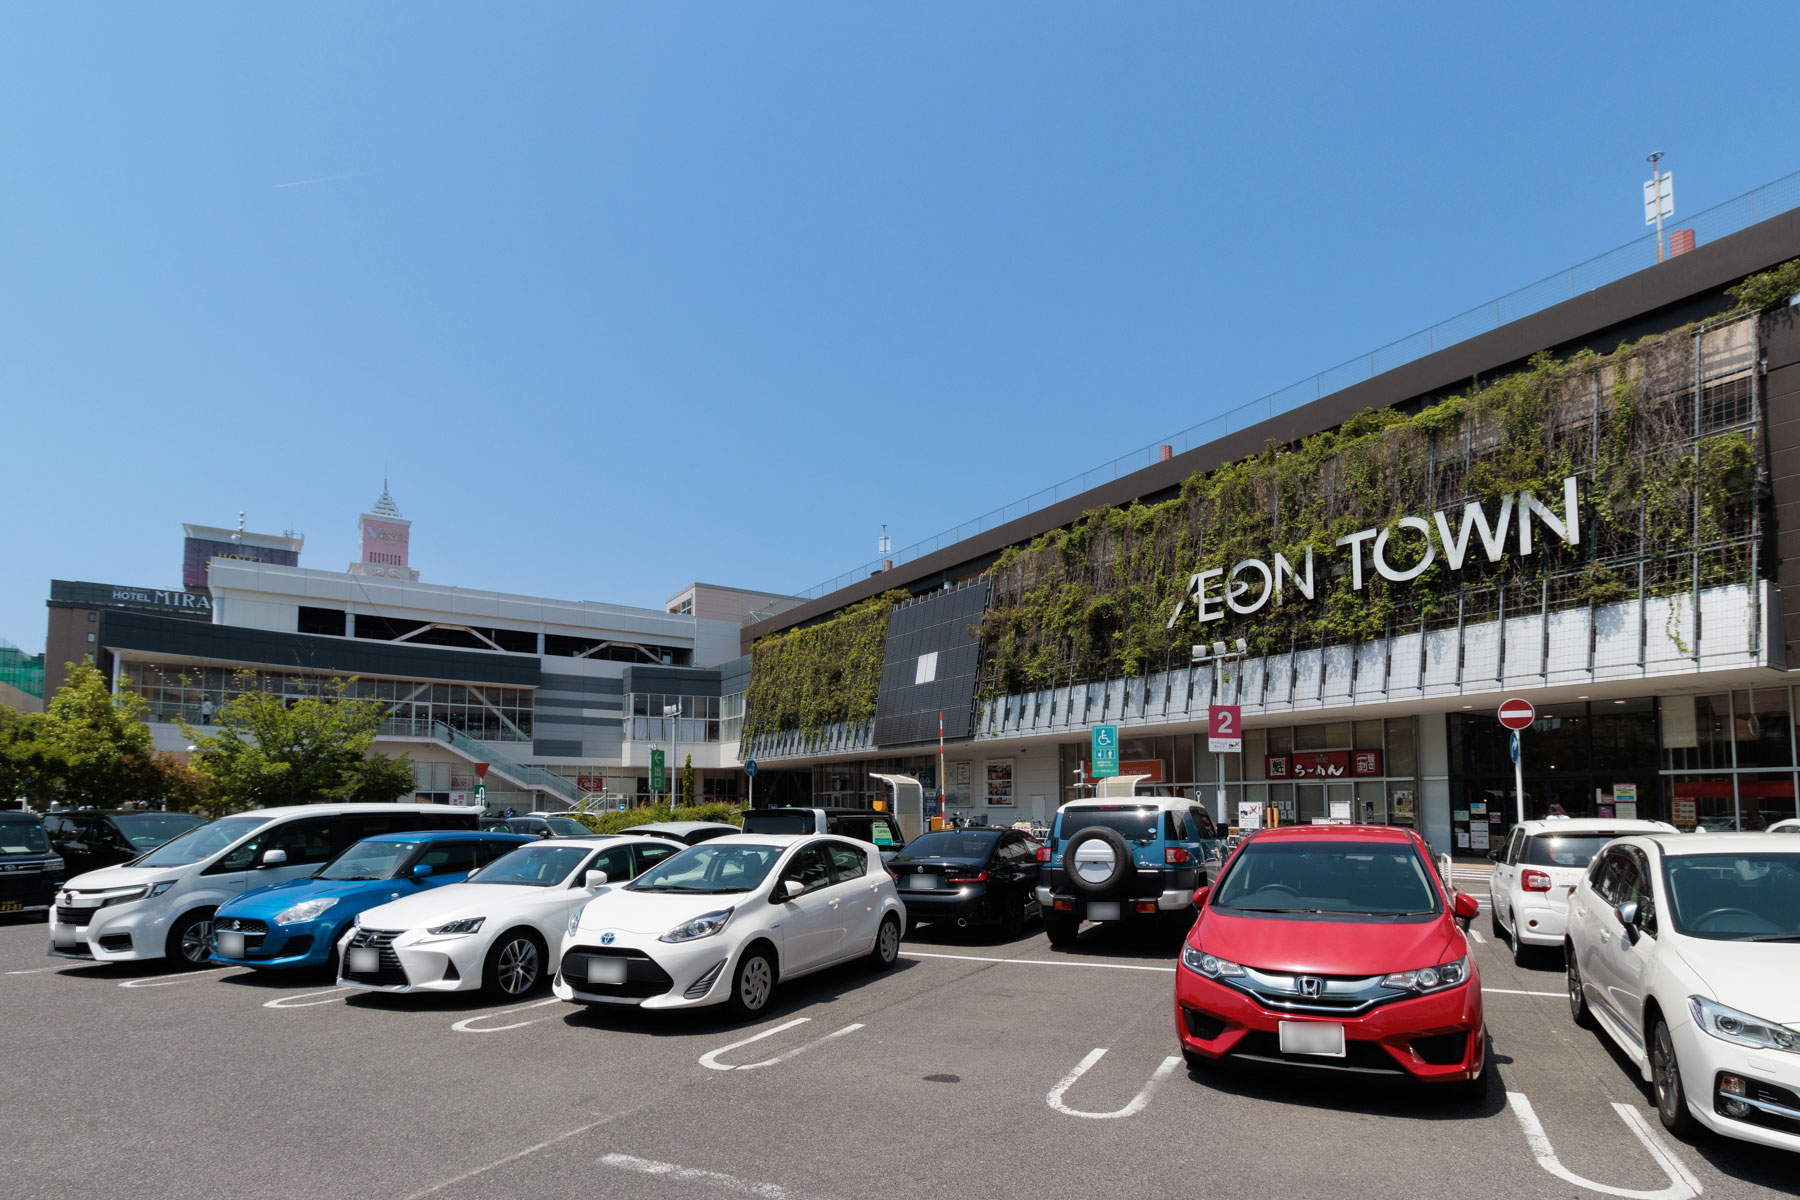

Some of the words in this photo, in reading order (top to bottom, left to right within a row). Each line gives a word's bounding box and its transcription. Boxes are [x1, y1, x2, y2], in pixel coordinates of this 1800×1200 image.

[1336, 477, 1579, 590] TOWN
[112, 591, 151, 602] HOTEL
[154, 590, 213, 608] MIRA
[1217, 711, 1233, 734] 2
